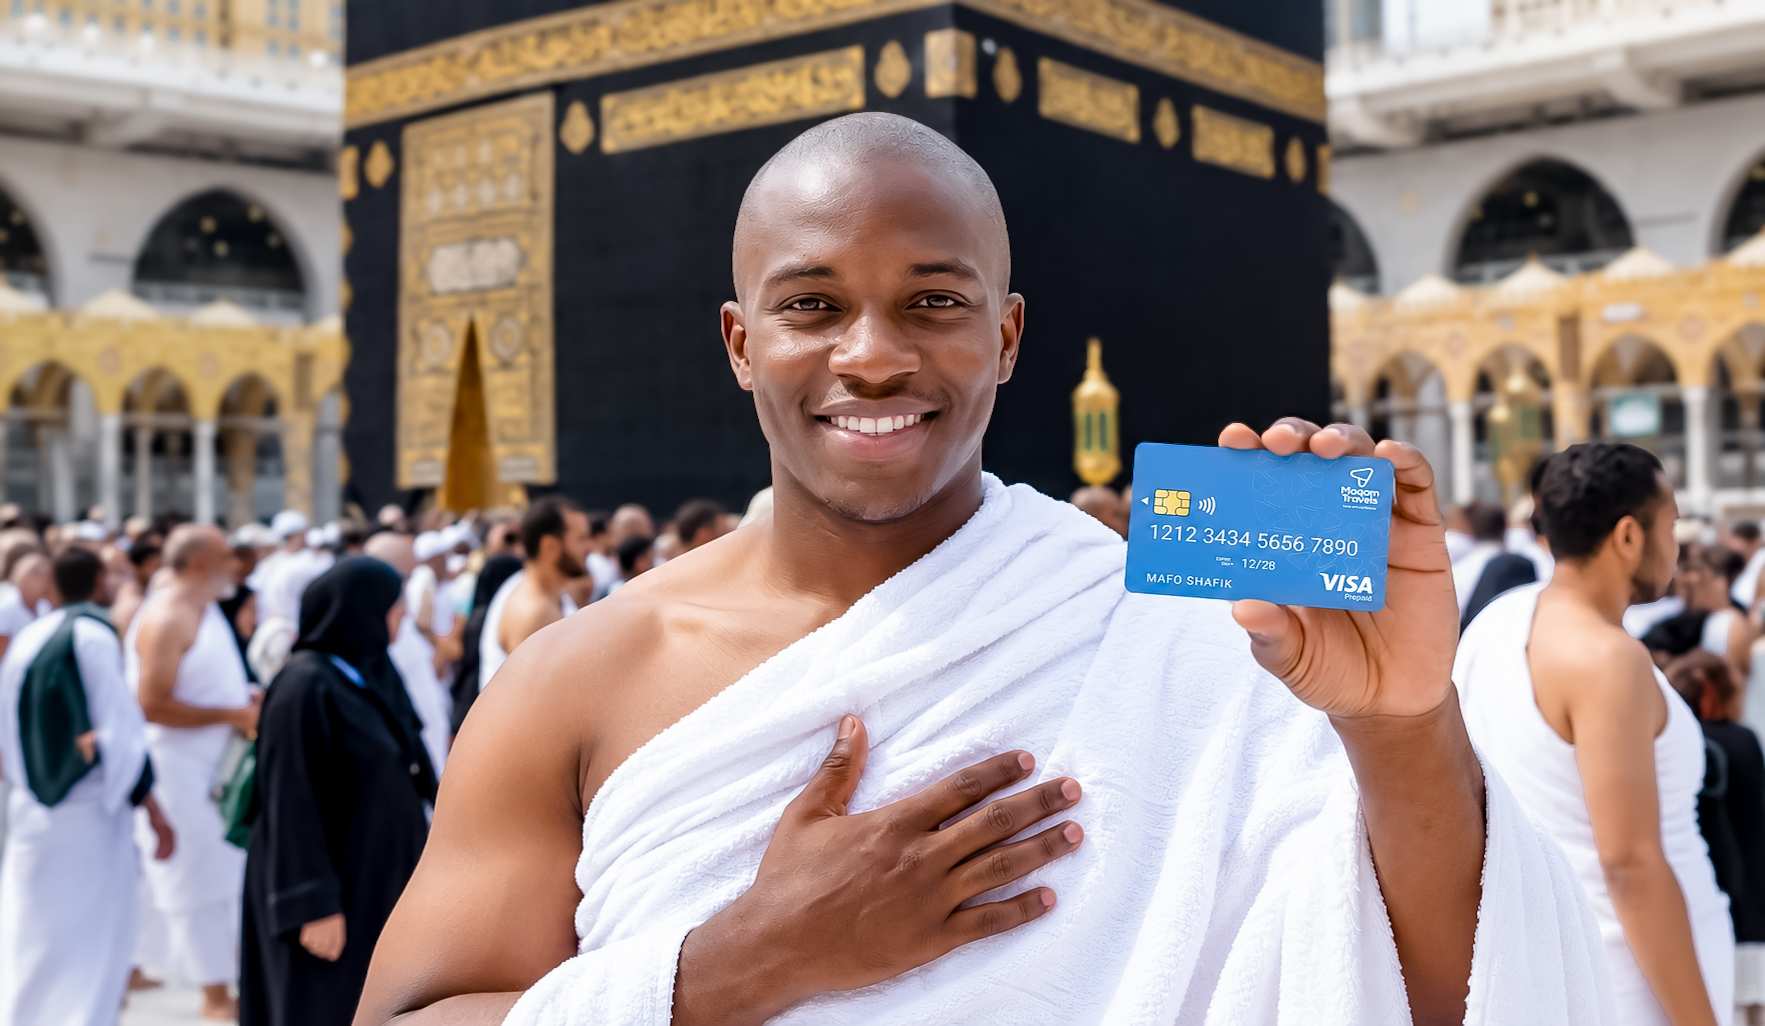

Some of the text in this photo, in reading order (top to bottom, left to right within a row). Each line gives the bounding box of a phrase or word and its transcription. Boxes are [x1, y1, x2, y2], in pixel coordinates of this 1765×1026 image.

[1342, 494, 1378, 505] Travels
[1150, 524, 1359, 557] 1212 3434 5656 7890
[1241, 558, 1276, 571] 12/28
[1146, 573, 1234, 589] MAFO SHAFIK
[1319, 573, 1373, 594] VISA
[1344, 593, 1373, 602] Prepaid
